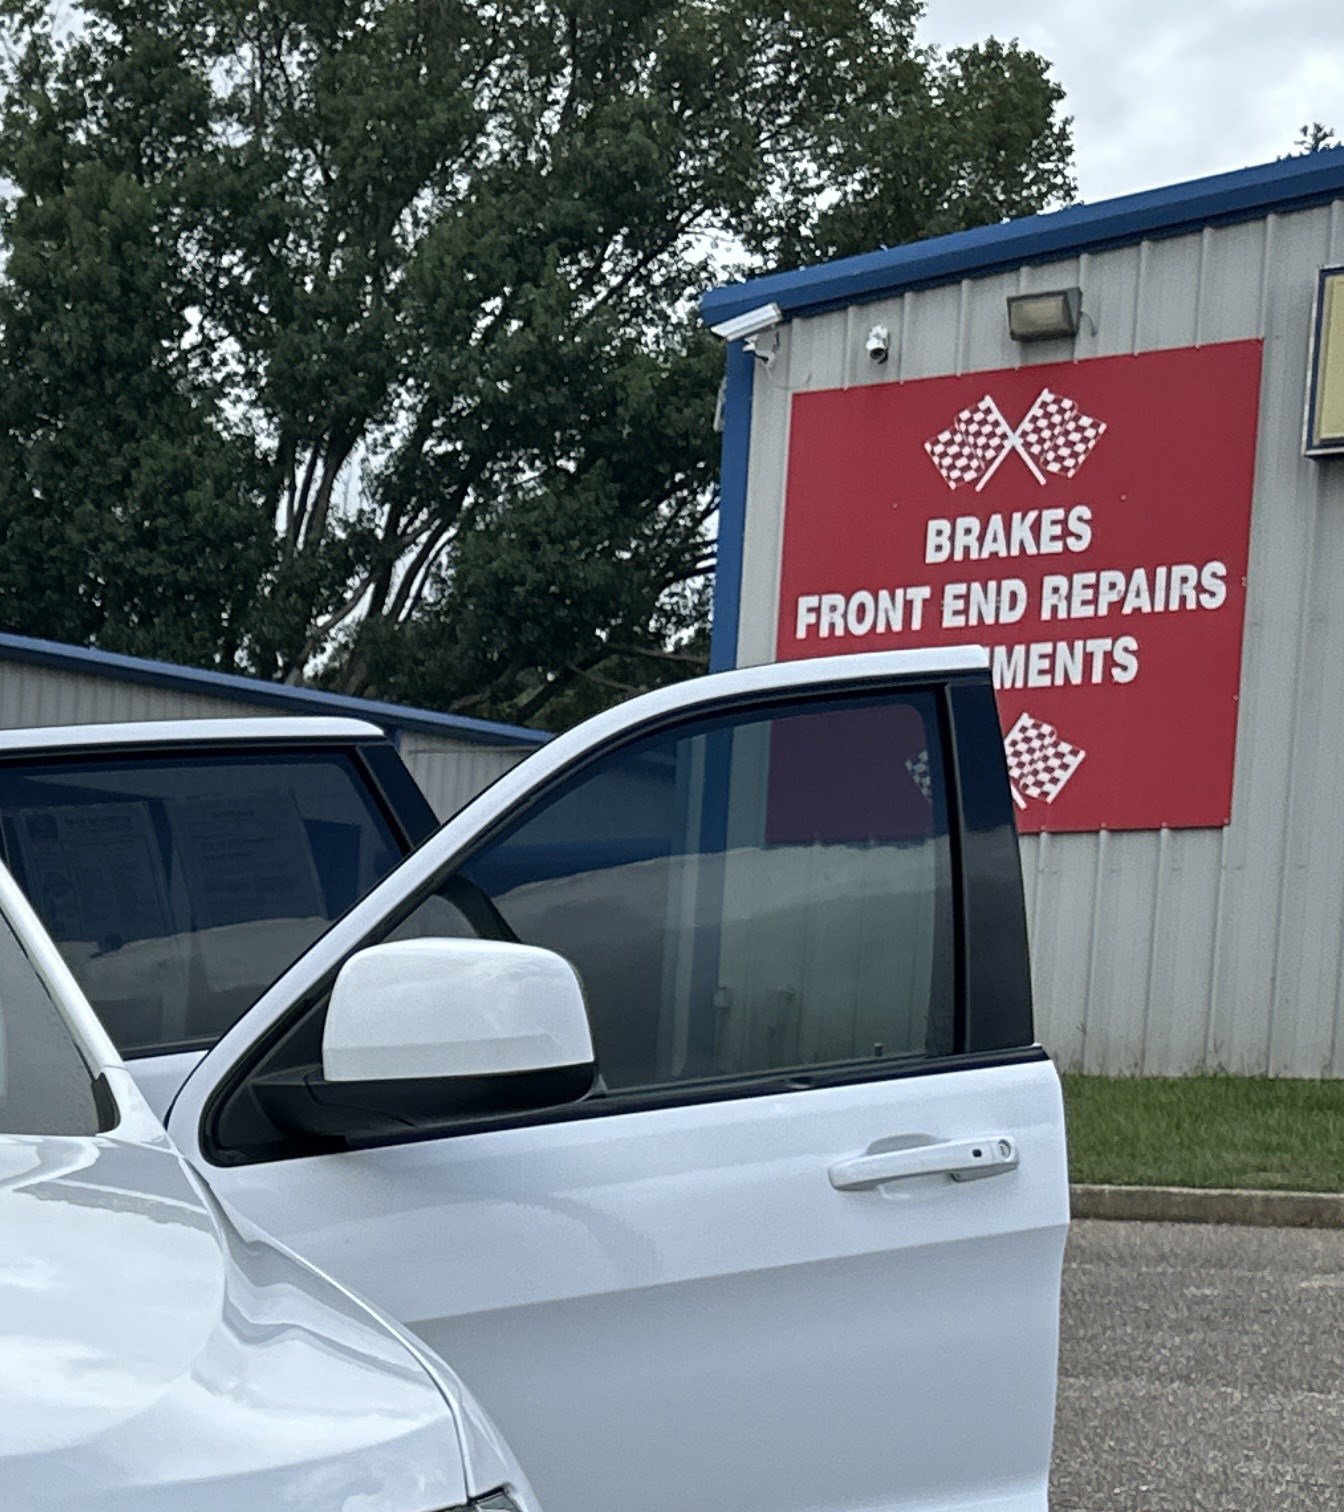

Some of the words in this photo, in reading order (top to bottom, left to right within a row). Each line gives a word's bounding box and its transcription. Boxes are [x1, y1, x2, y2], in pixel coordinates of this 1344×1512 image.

[925, 505, 1093, 564] BRAKES
[796, 585, 930, 640] FRONT
[942, 578, 1028, 629] END
[1041, 561, 1228, 621] REPAIRS
[991, 635, 1139, 691] MENTS
